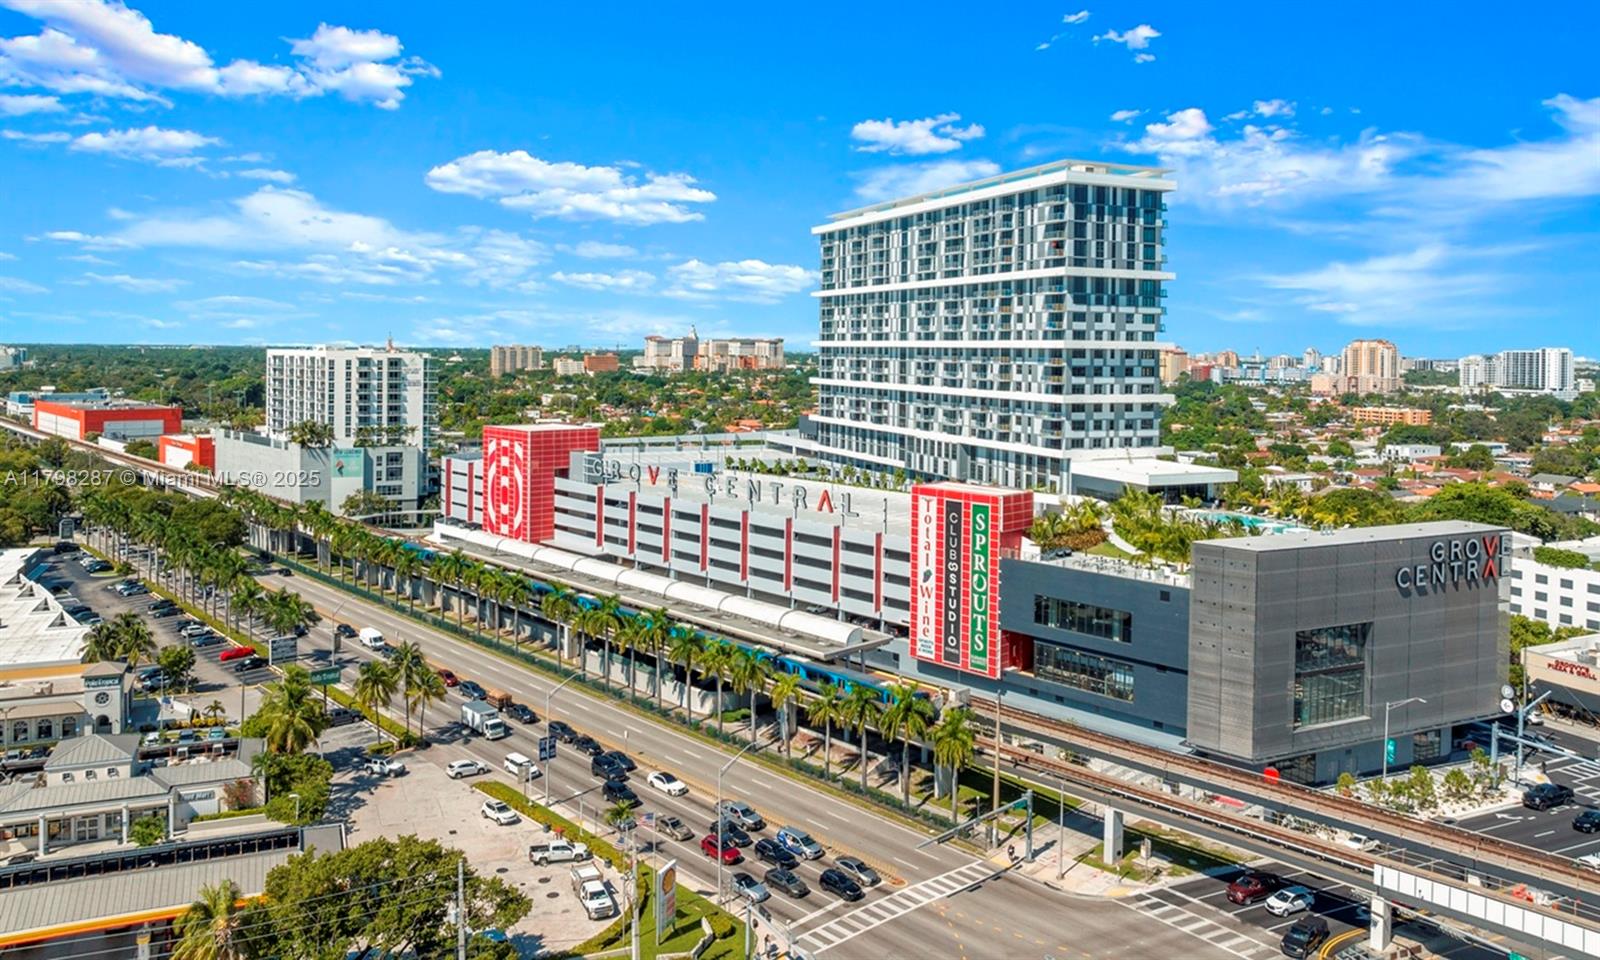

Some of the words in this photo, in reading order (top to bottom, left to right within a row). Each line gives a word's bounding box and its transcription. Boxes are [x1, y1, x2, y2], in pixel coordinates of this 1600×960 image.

[705, 472, 858, 517] CENTRAL
[921, 498, 934, 567] Total
[948, 512, 959, 561] CLUB
[1432, 535, 1511, 562] GROVE
[972, 513, 988, 652] SPROUTS
[1397, 558, 1511, 588] CENTRAL
[919, 584, 934, 638] Wine
[947, 573, 958, 647] STUDIO
[1576, 670, 1597, 681] GRILL
